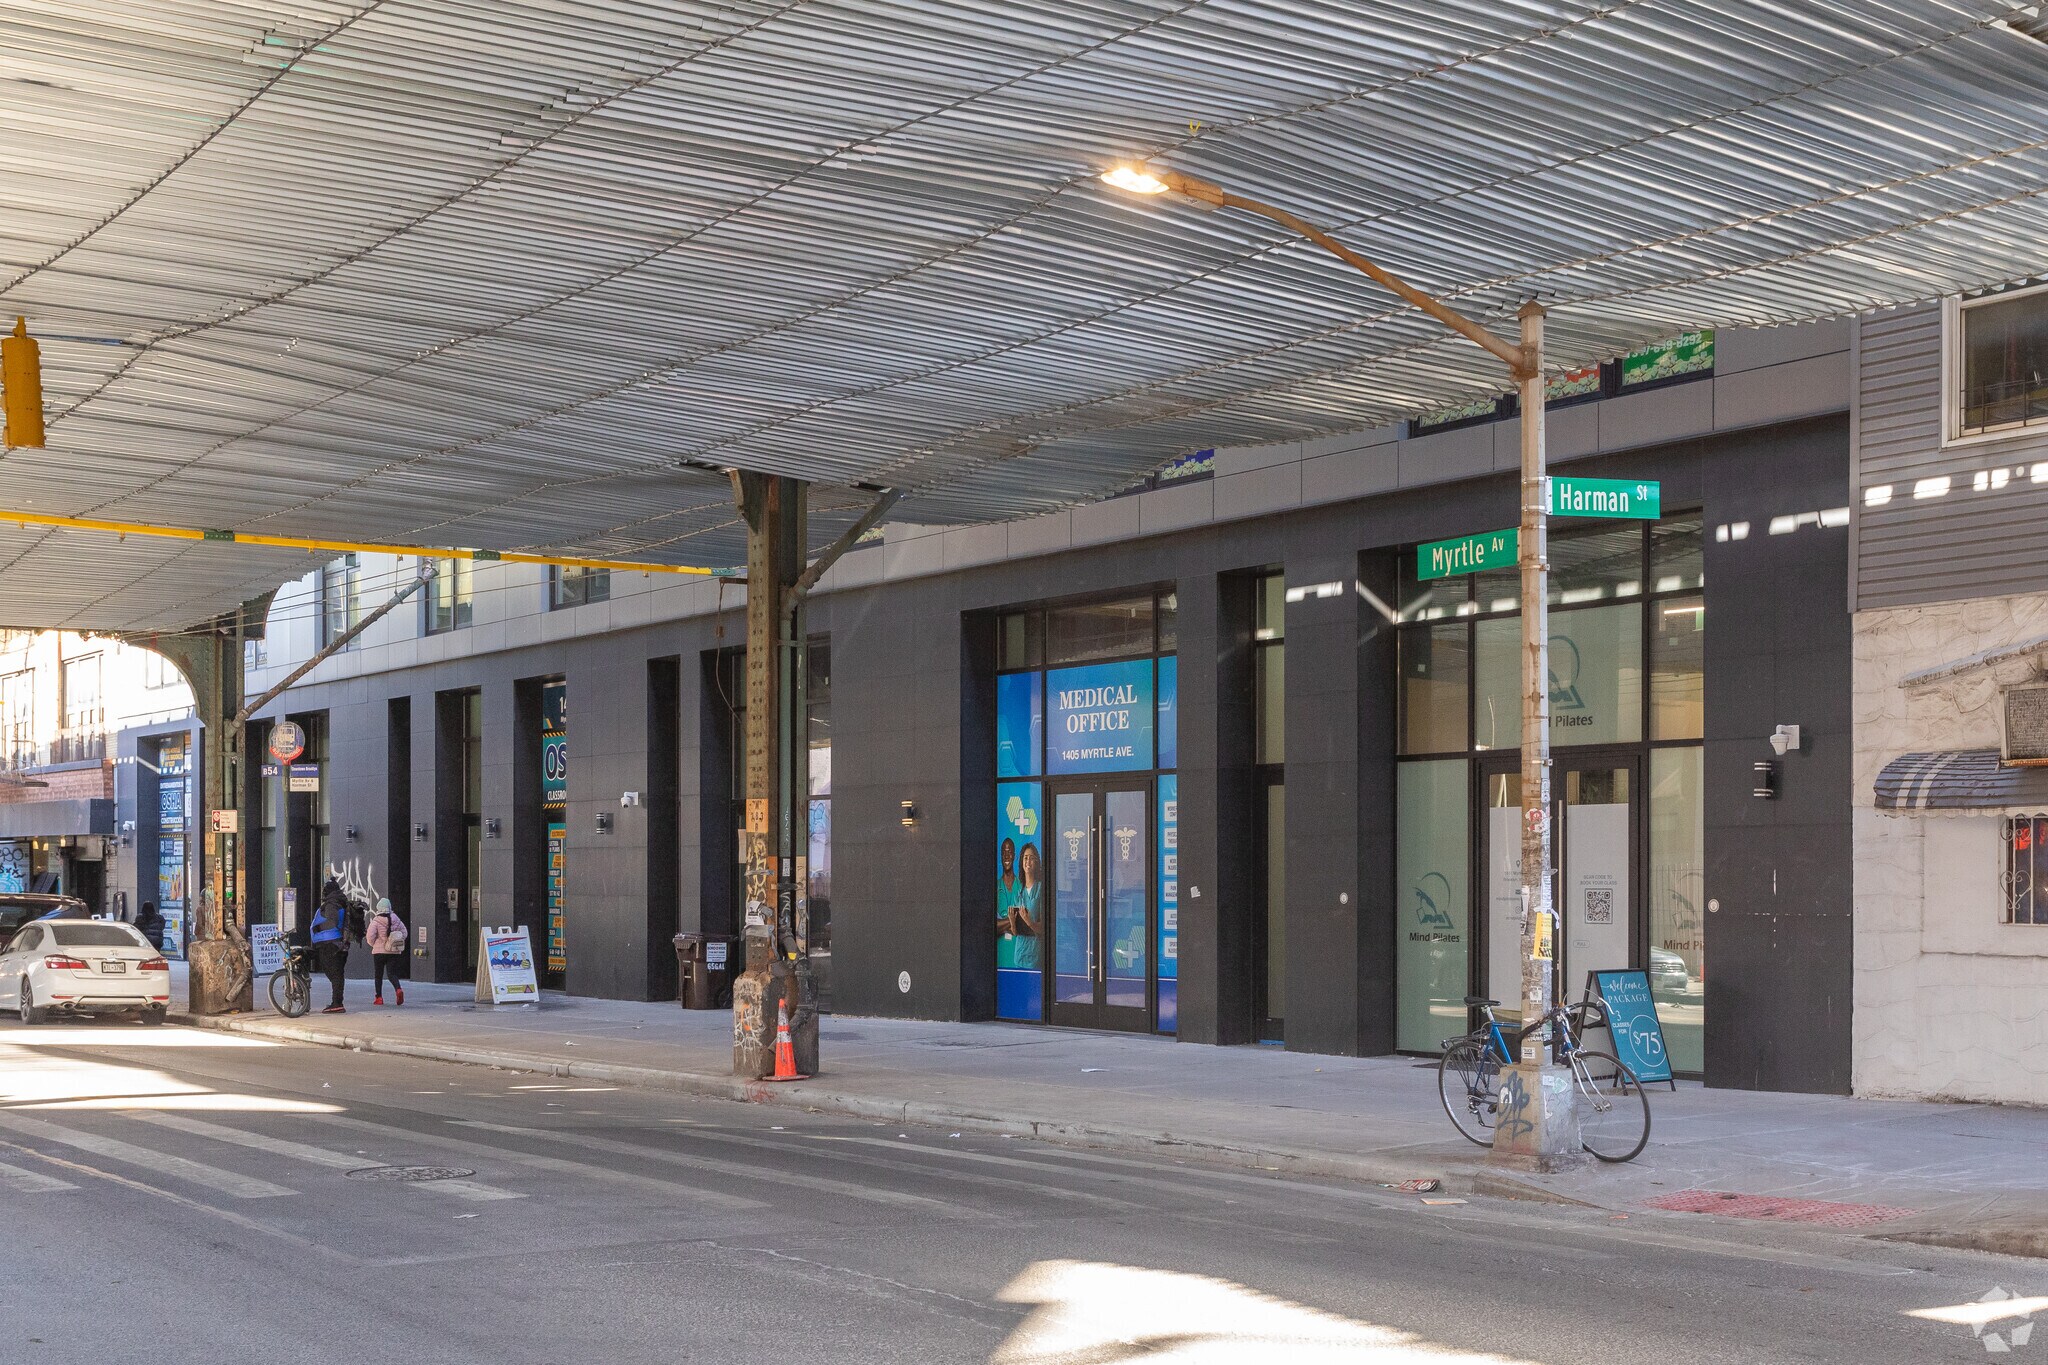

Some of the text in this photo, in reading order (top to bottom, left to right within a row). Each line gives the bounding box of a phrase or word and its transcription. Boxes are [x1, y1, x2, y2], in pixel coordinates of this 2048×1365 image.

[1560, 483, 1648, 513] Harman St
[1432, 537, 1504, 576] Myrtle Av
[1059, 684, 1138, 710] MEDICAL
[1066, 710, 1129, 734] OFFICE
[1555, 715, 1593, 727] Pilates
[1062, 746, 1134, 760] 1405 MYRTLE AVE.
[263, 766, 278, 775] B54
[161, 793, 182, 810] OSHA
[1409, 932, 1460, 943] Mind Pilates
[1663, 940, 1690, 950] Mind
[1600, 976, 1648, 994] welcome
[1608, 993, 1649, 1003] PACKAGE
[1616, 1010, 1622, 1022] 3
[1633, 1031, 1661, 1055] $75
